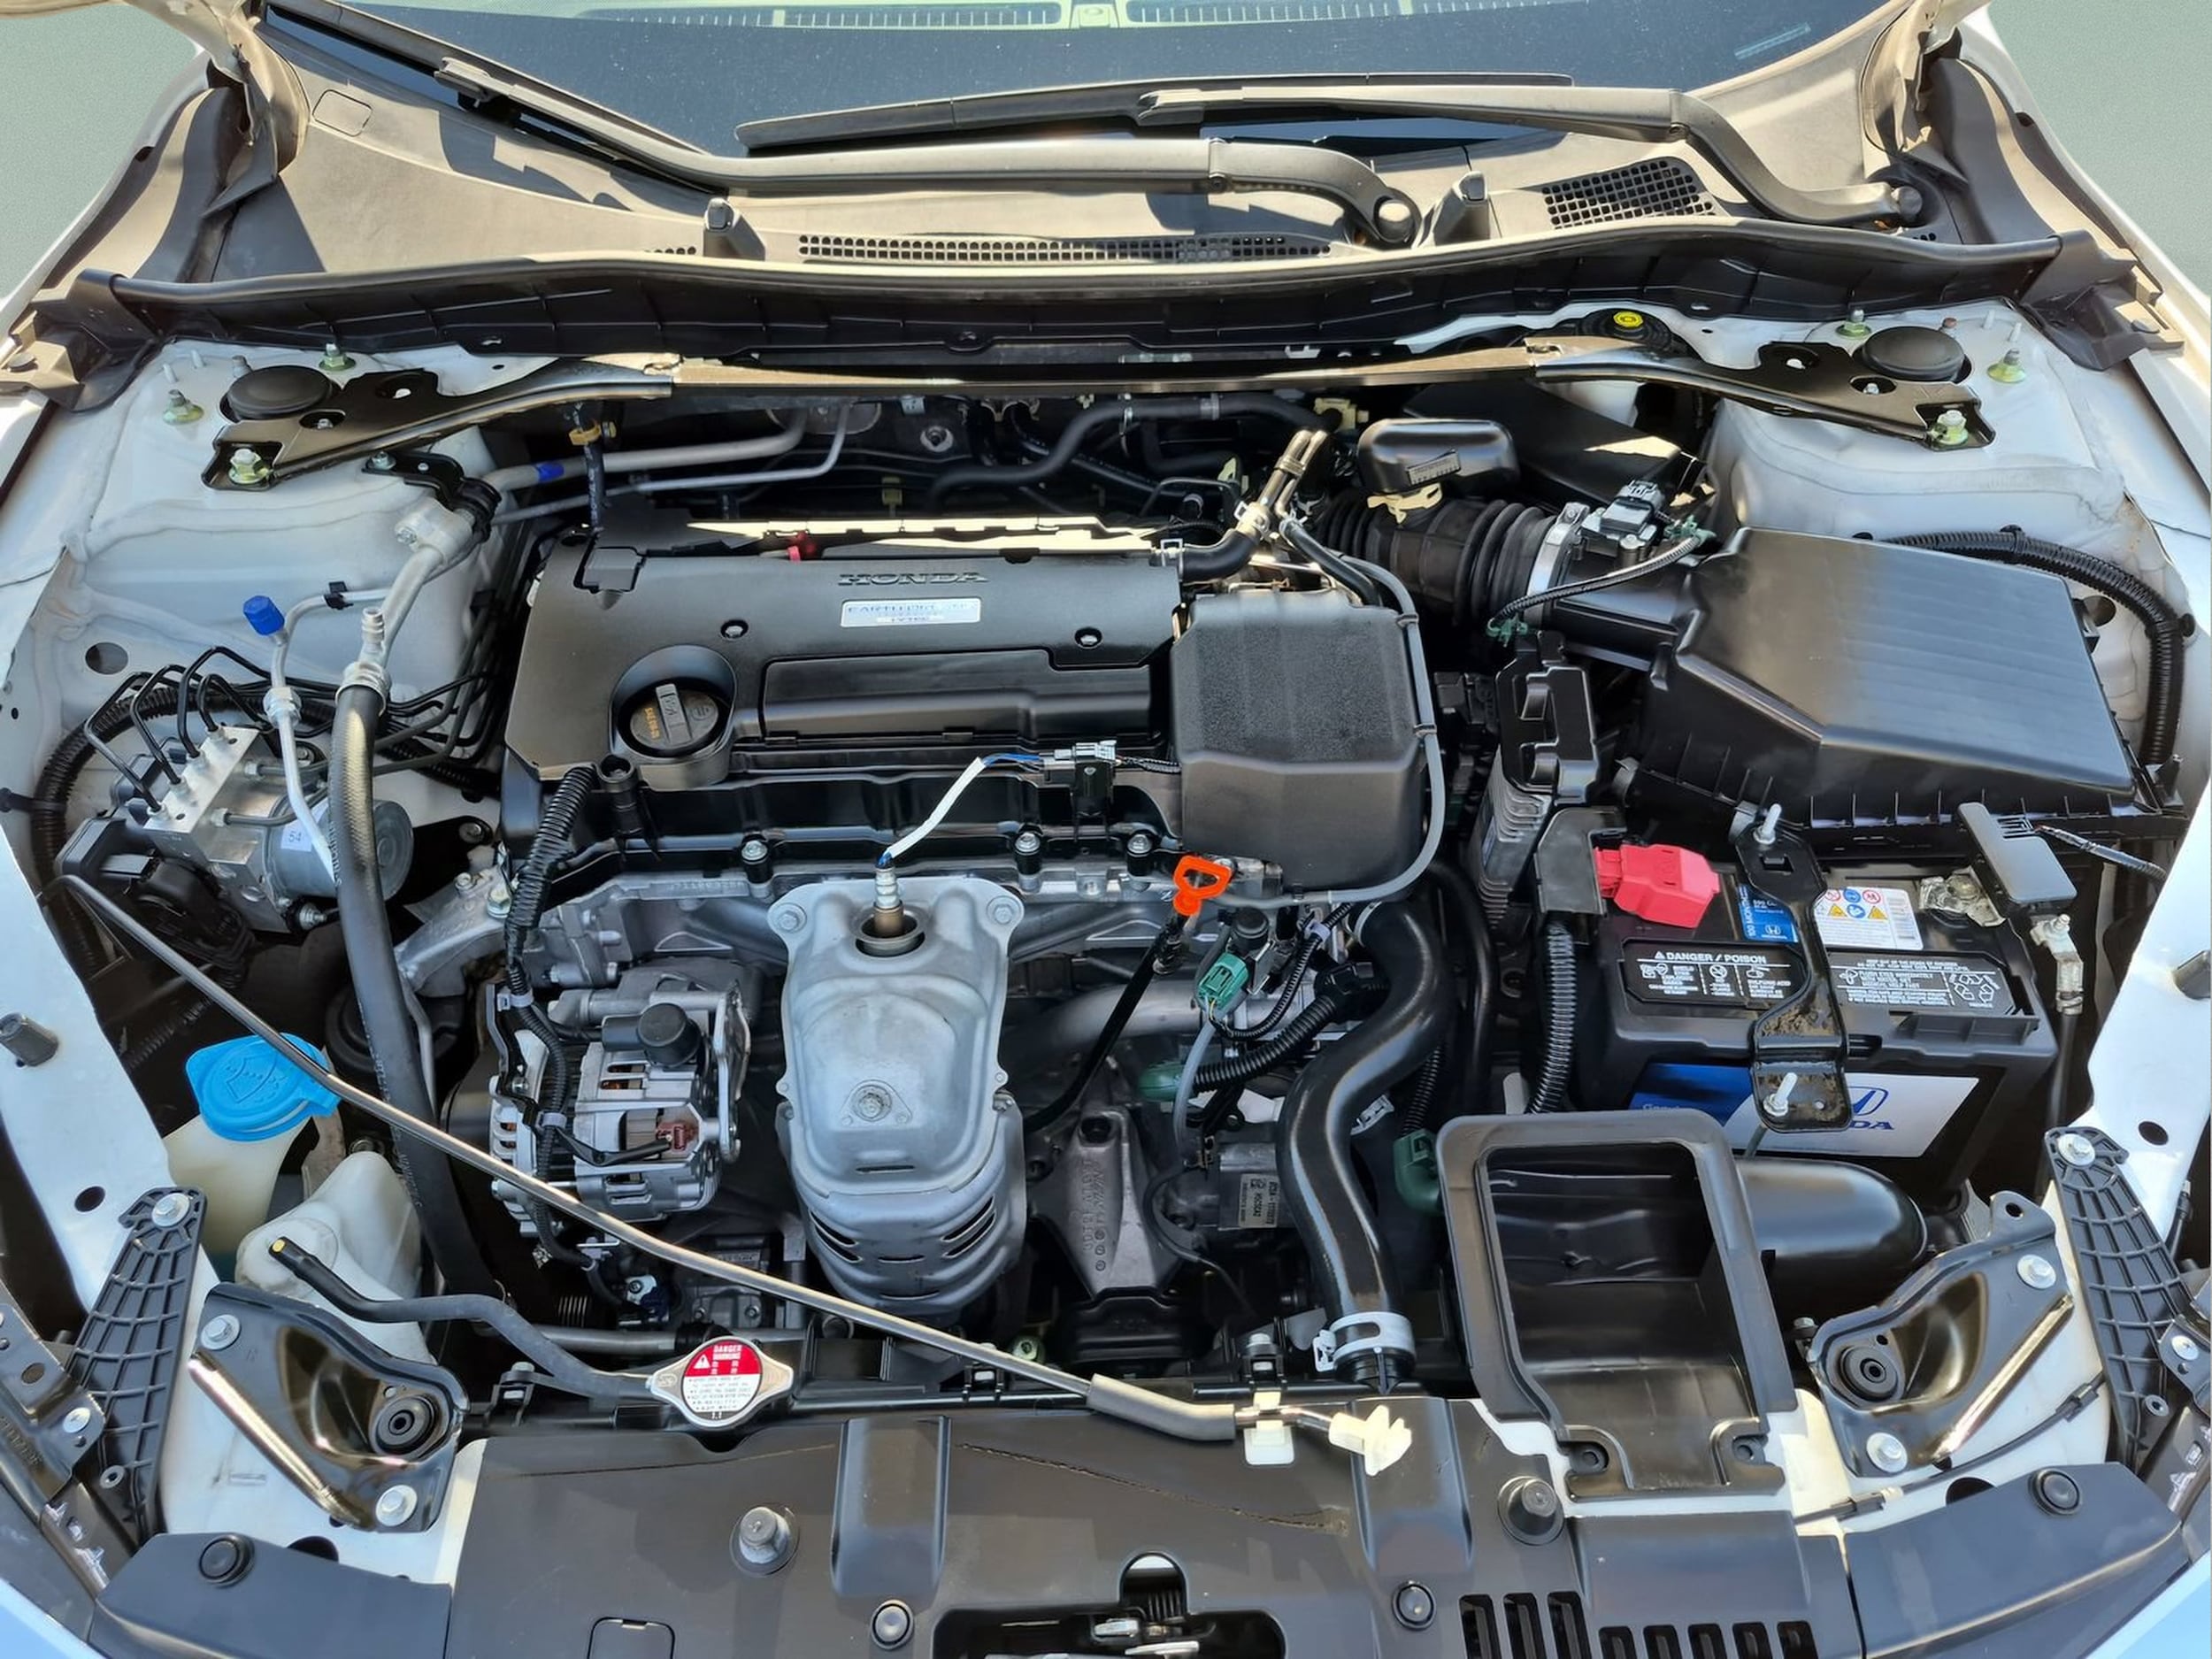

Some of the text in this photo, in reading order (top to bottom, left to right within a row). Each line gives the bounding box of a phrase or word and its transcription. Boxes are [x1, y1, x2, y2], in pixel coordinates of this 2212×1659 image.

[838, 572, 989, 586] HONDA
[1666, 951, 1713, 962] DANGER
[1724, 954, 1767, 964] POISON
[713, 1344, 741, 1353] DANGER
